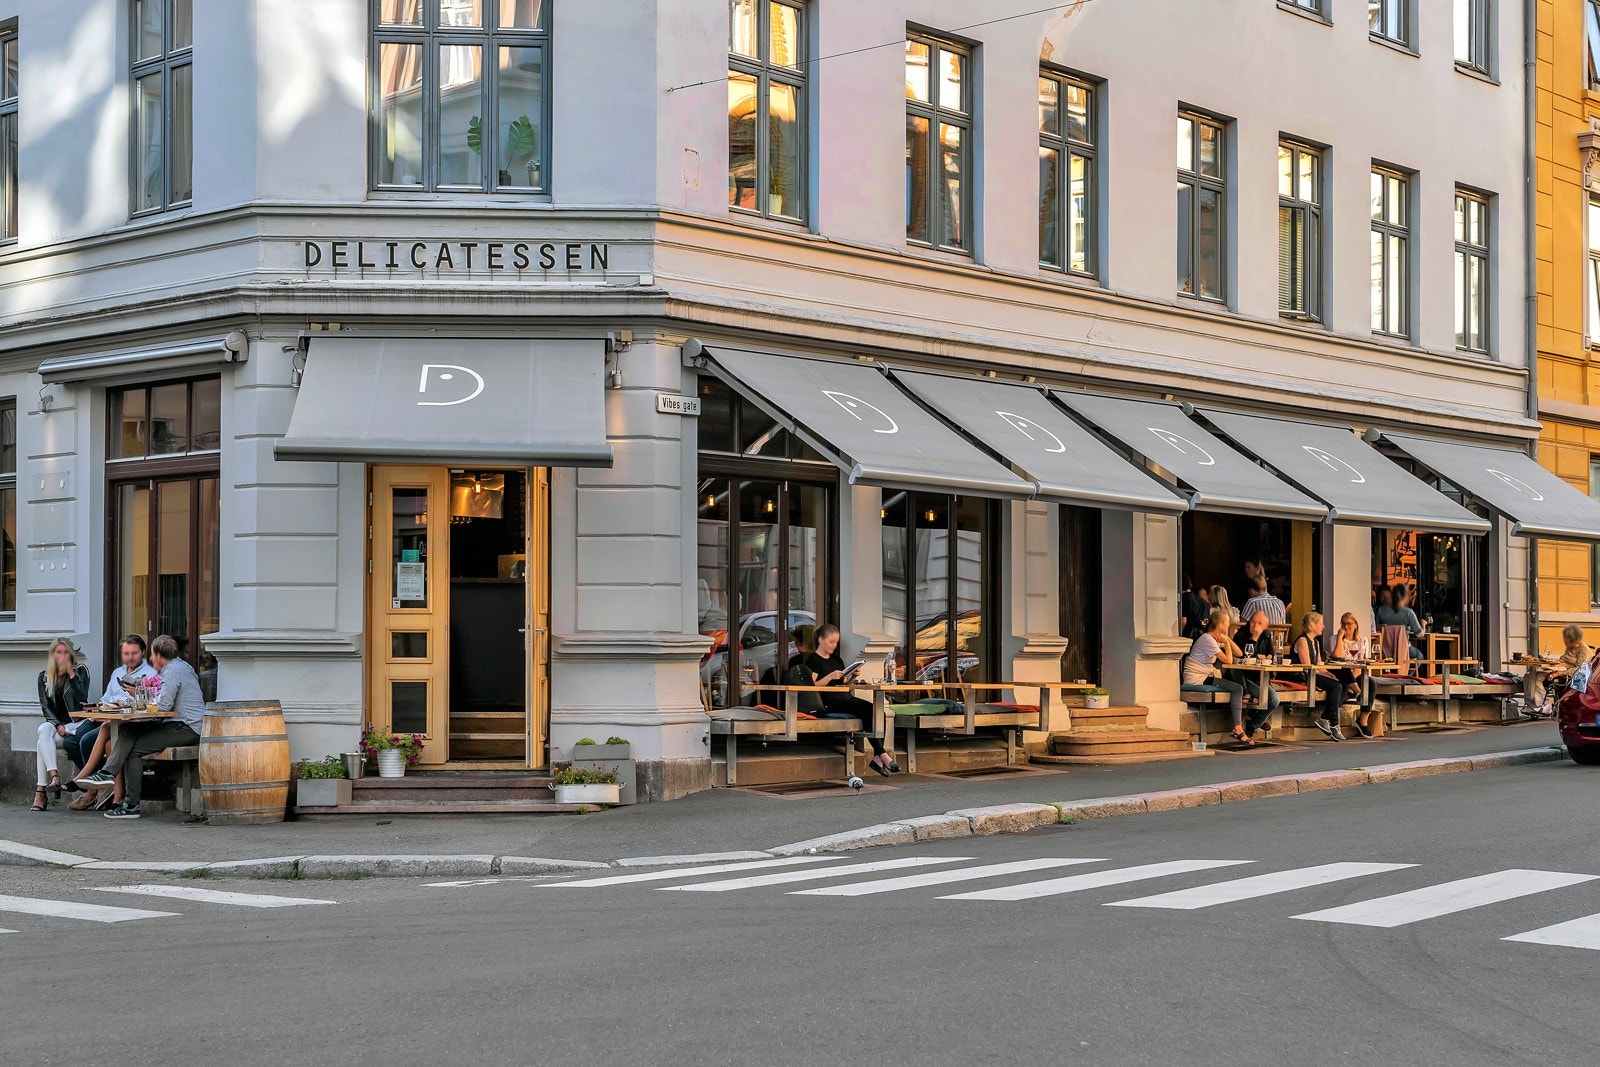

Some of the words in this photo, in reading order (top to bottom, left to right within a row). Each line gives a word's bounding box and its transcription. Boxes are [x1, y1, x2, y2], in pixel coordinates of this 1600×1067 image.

[305, 241, 608, 270] DELICATESSEN
[662, 397, 680, 410] Vibes
[683, 401, 697, 412] gate
